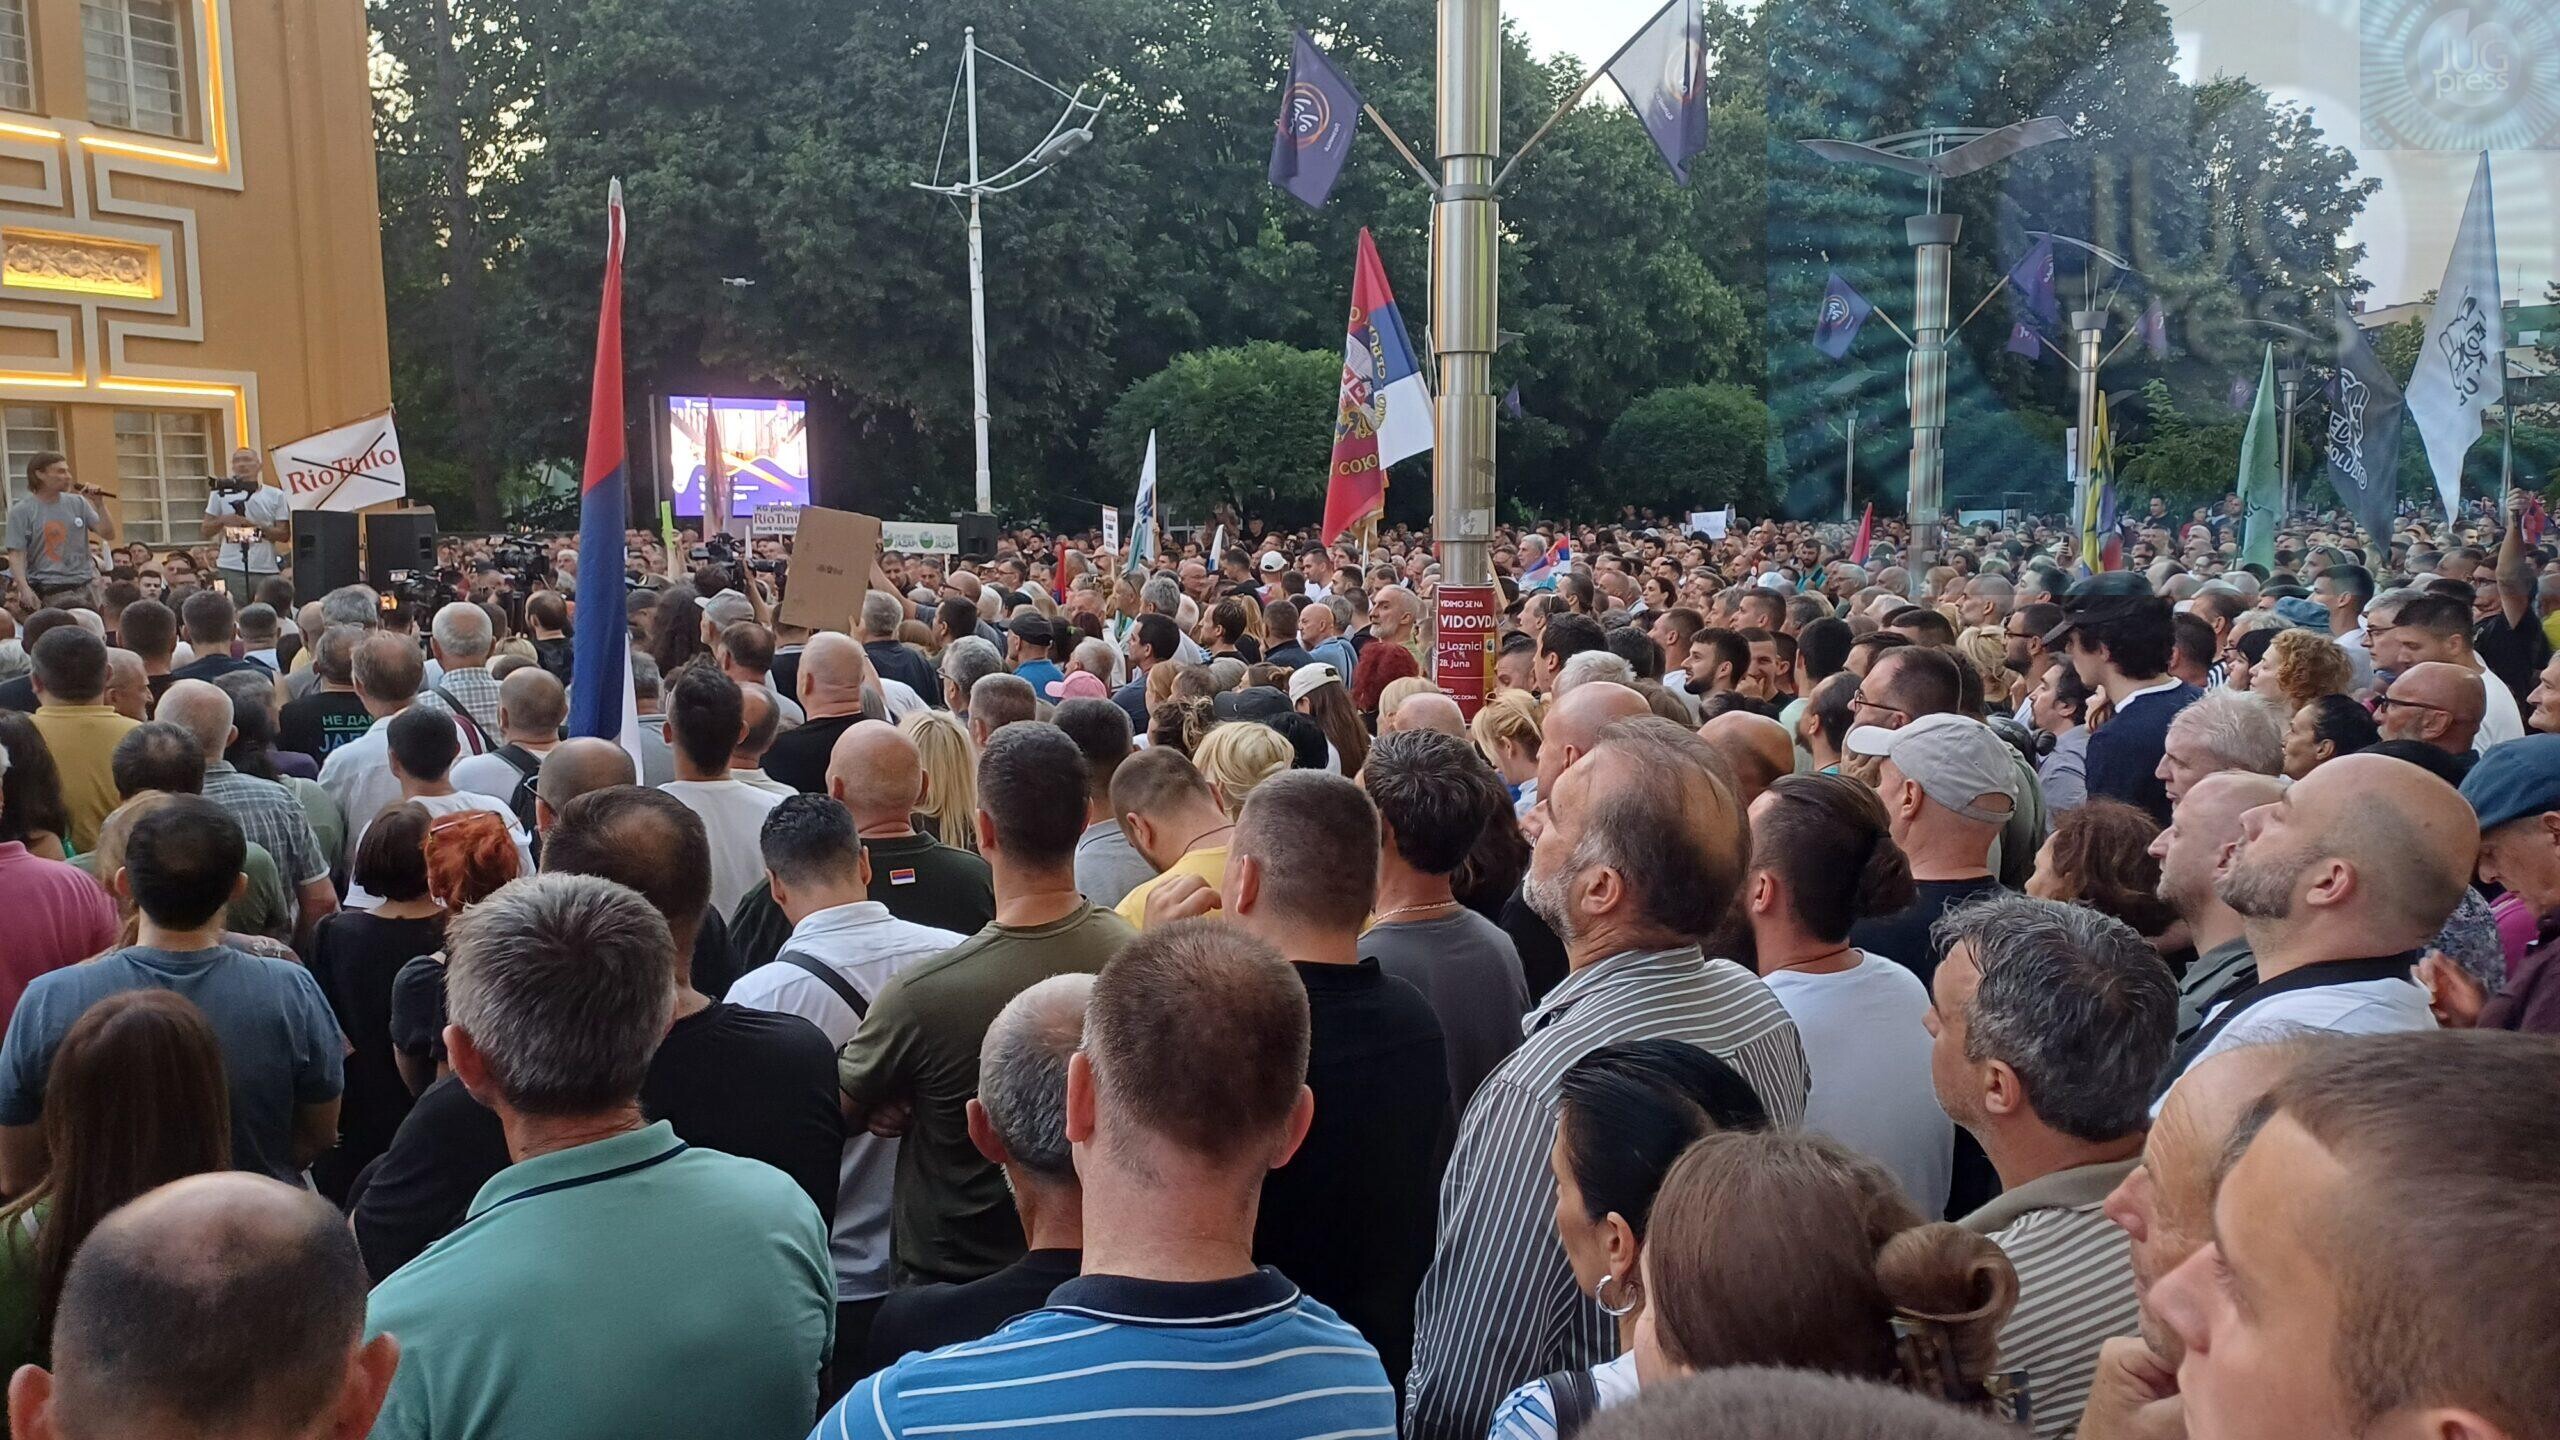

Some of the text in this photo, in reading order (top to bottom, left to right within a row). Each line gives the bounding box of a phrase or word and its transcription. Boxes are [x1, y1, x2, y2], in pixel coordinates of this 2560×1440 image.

[754, 513, 798, 524] RioTint
[1440, 600, 1483, 608] VIDIMO SE NA
[1440, 614, 1496, 629] VIDOVDA
[1439, 641, 1482, 651] u Loznici
[1450, 659, 1470, 669] juna
[322, 714, 343, 726] НЕ
